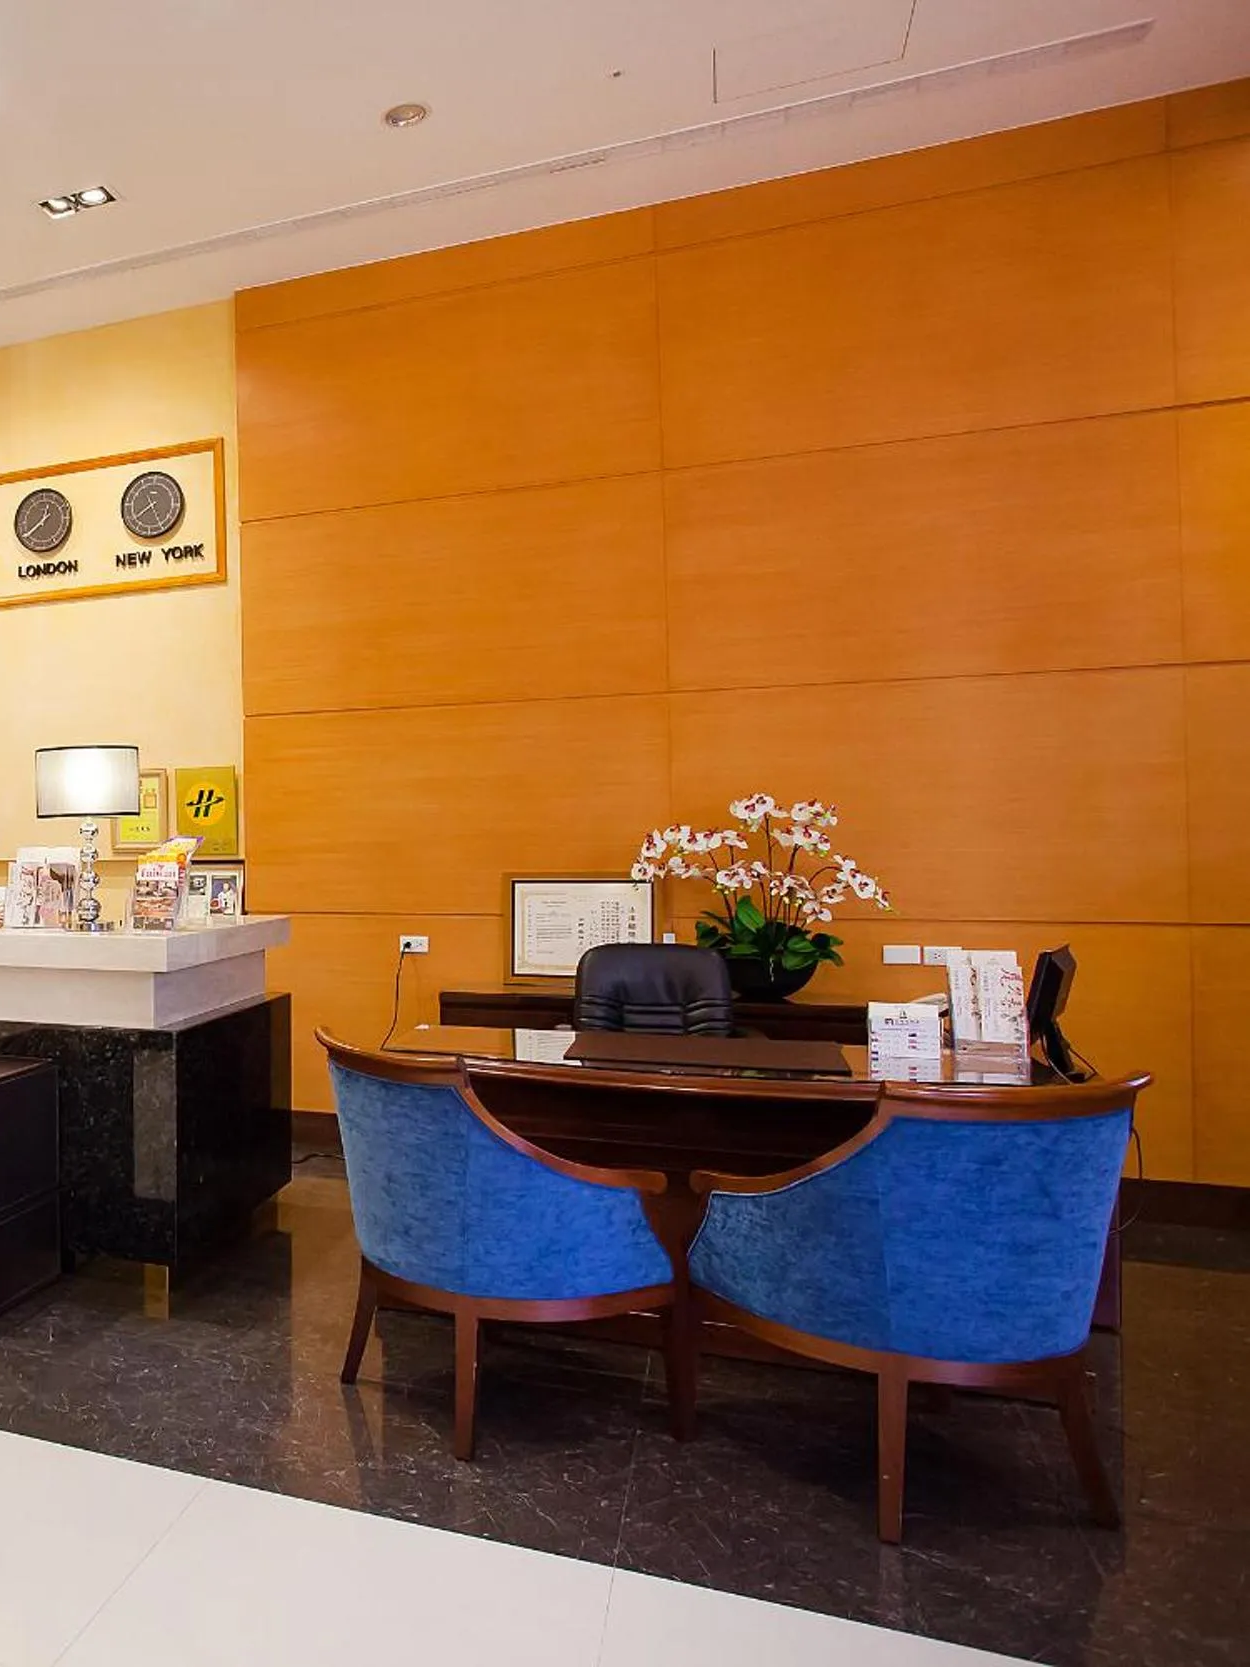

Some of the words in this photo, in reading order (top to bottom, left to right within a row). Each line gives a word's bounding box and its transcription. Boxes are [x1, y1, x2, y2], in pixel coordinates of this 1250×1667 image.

[115, 551, 153, 568] NEW
[161, 543, 205, 561] YORK
[18, 560, 79, 578] LONDON
